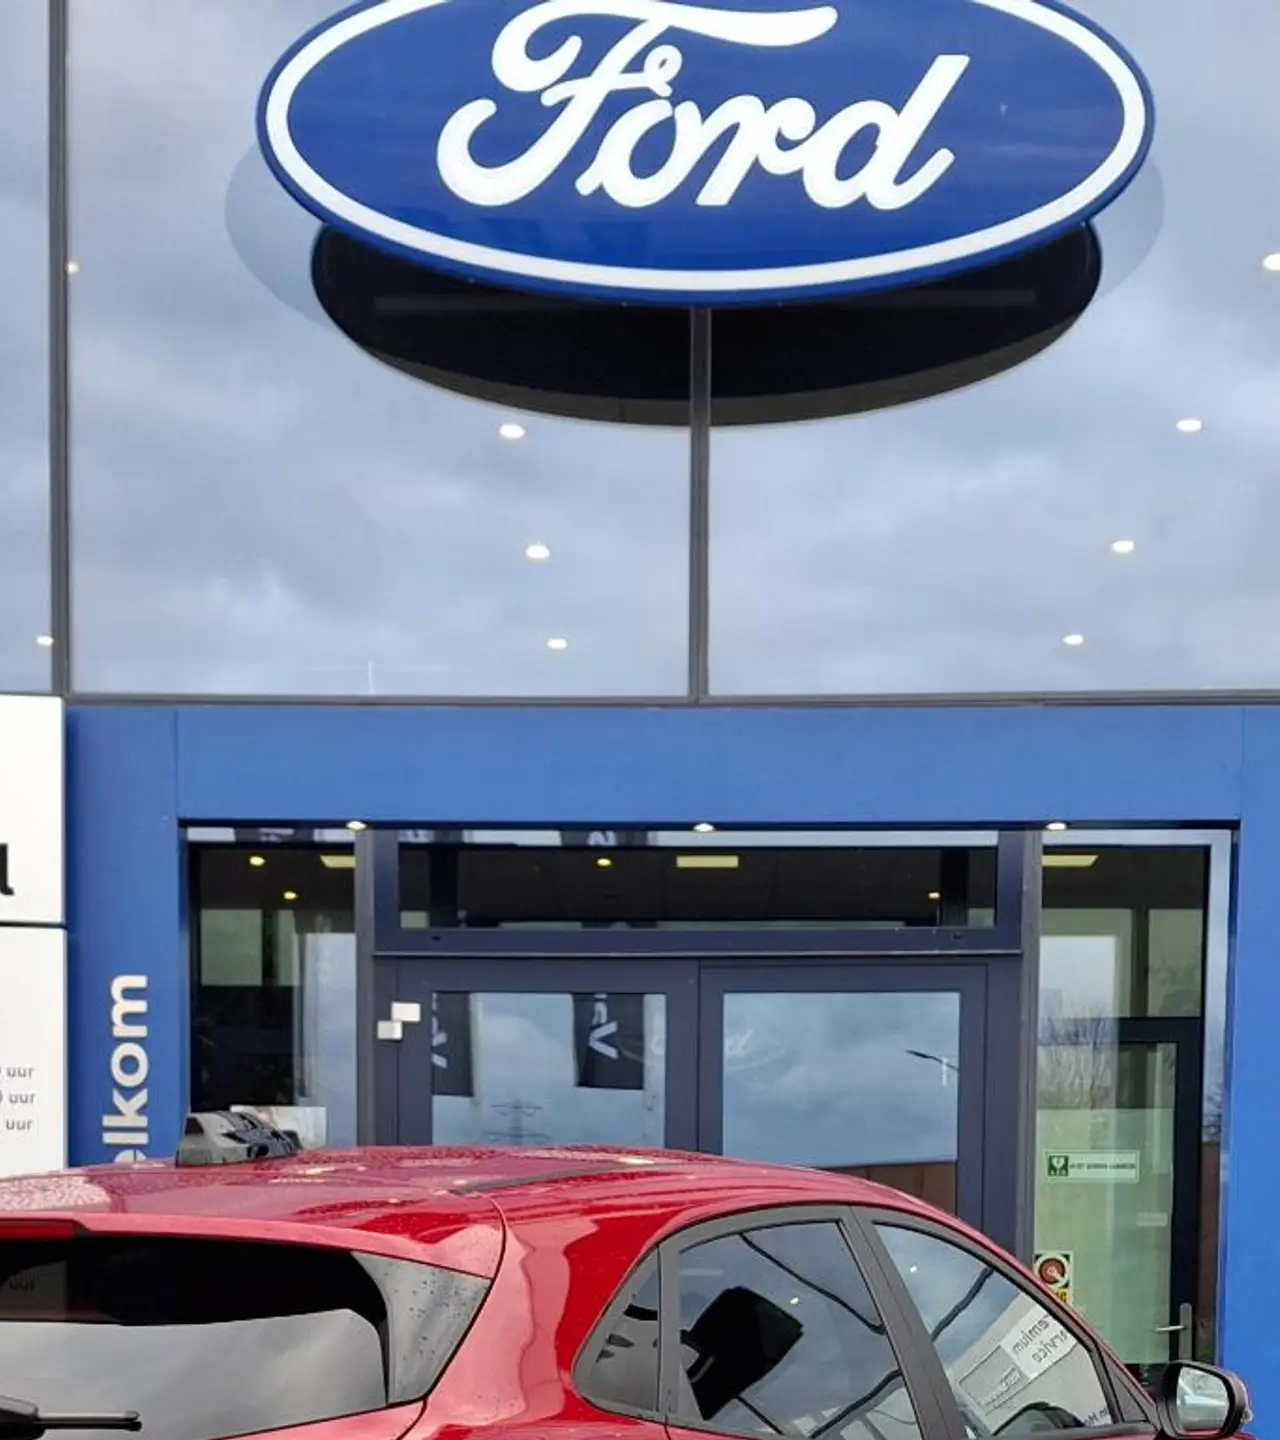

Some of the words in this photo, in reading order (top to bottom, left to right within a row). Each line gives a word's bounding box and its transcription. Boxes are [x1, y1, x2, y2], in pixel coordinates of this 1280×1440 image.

[436, 0, 970, 211] Ford
[6, 1067, 34, 1078] uur
[8, 1093, 36, 1104] uur
[5, 1120, 33, 1130] uur
